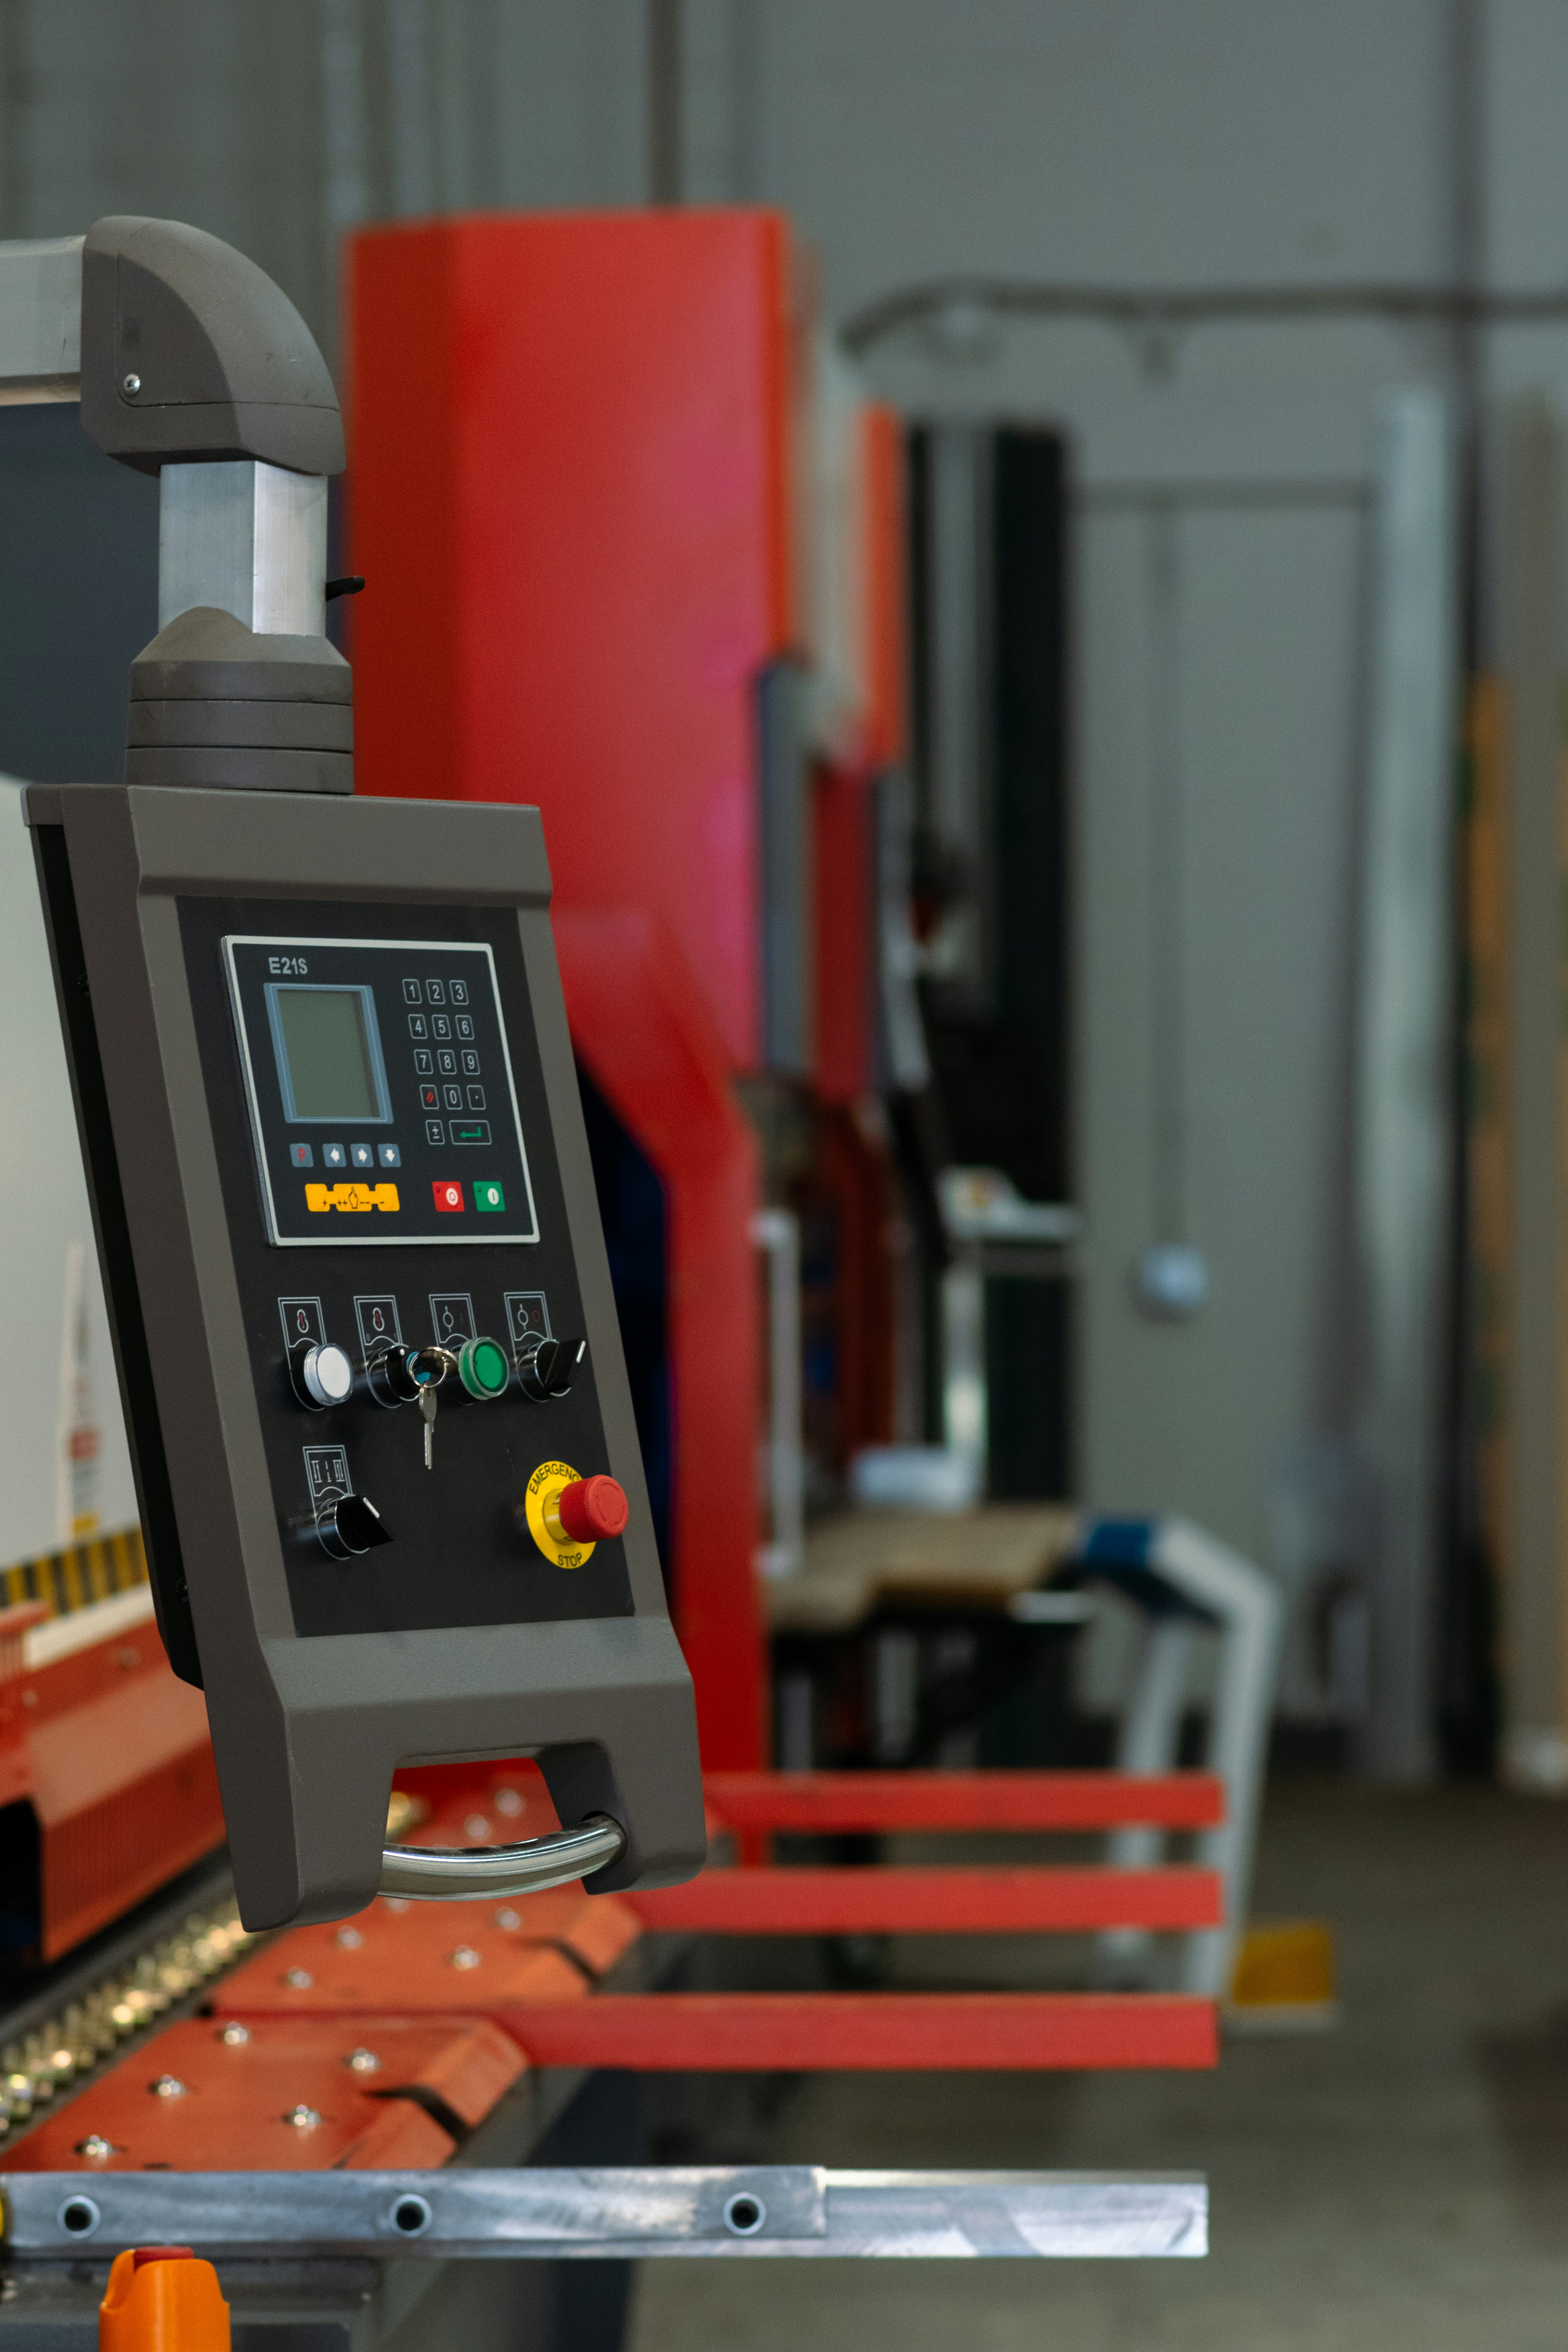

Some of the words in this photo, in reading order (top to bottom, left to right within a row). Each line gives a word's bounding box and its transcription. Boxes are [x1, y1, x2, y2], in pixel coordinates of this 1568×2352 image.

[268, 957, 308, 975] E21S
[409, 985, 416, 998] 1
[432, 985, 440, 998] 2
[455, 985, 464, 1000] 3
[415, 1020, 422, 1033] 4
[438, 1020, 446, 1034] 5
[462, 1020, 469, 1034] 6
[420, 1055, 426, 1069] 7
[444, 1055, 451, 1069] 8
[467, 1055, 475, 1069] 9
[450, 1090, 457, 1104] 0
[298, 1148, 305, 1162] P
[529, 1463, 580, 1495] EMERGENC
[557, 1553, 583, 1567] STOP
